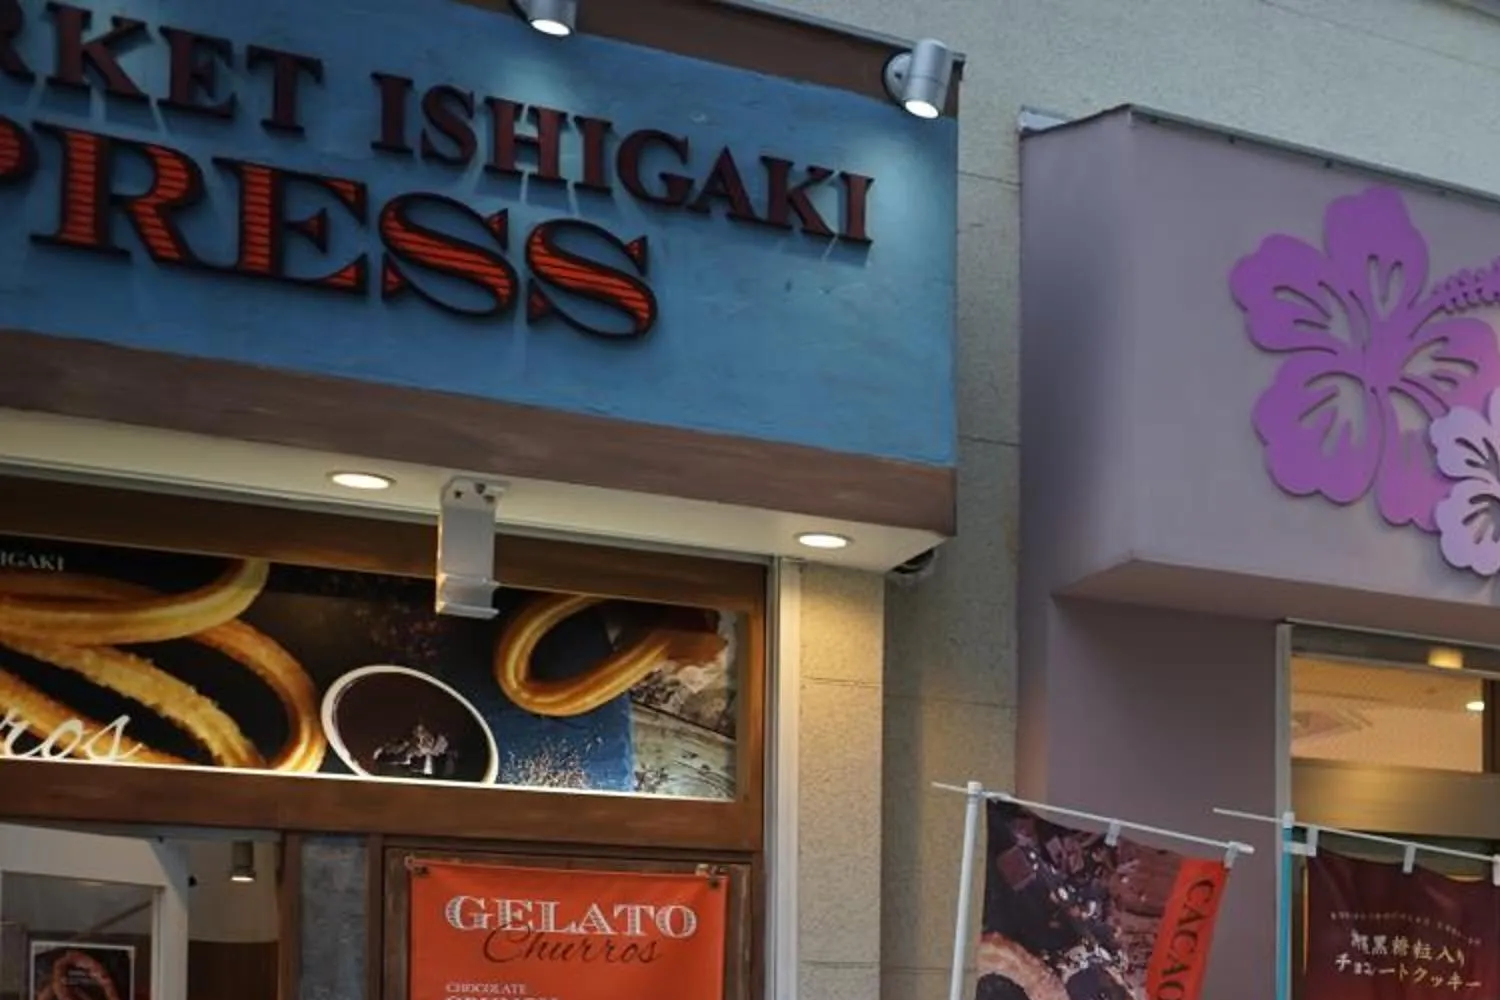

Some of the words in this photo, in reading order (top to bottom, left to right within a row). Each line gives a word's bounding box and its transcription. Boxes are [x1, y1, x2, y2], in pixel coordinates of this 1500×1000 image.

[370, 71, 876, 244] ISHIGAKI
[445, 895, 698, 939] GELATO
[483, 923, 660, 964] Churros
[445, 983, 526, 994] CHOCOLATE
